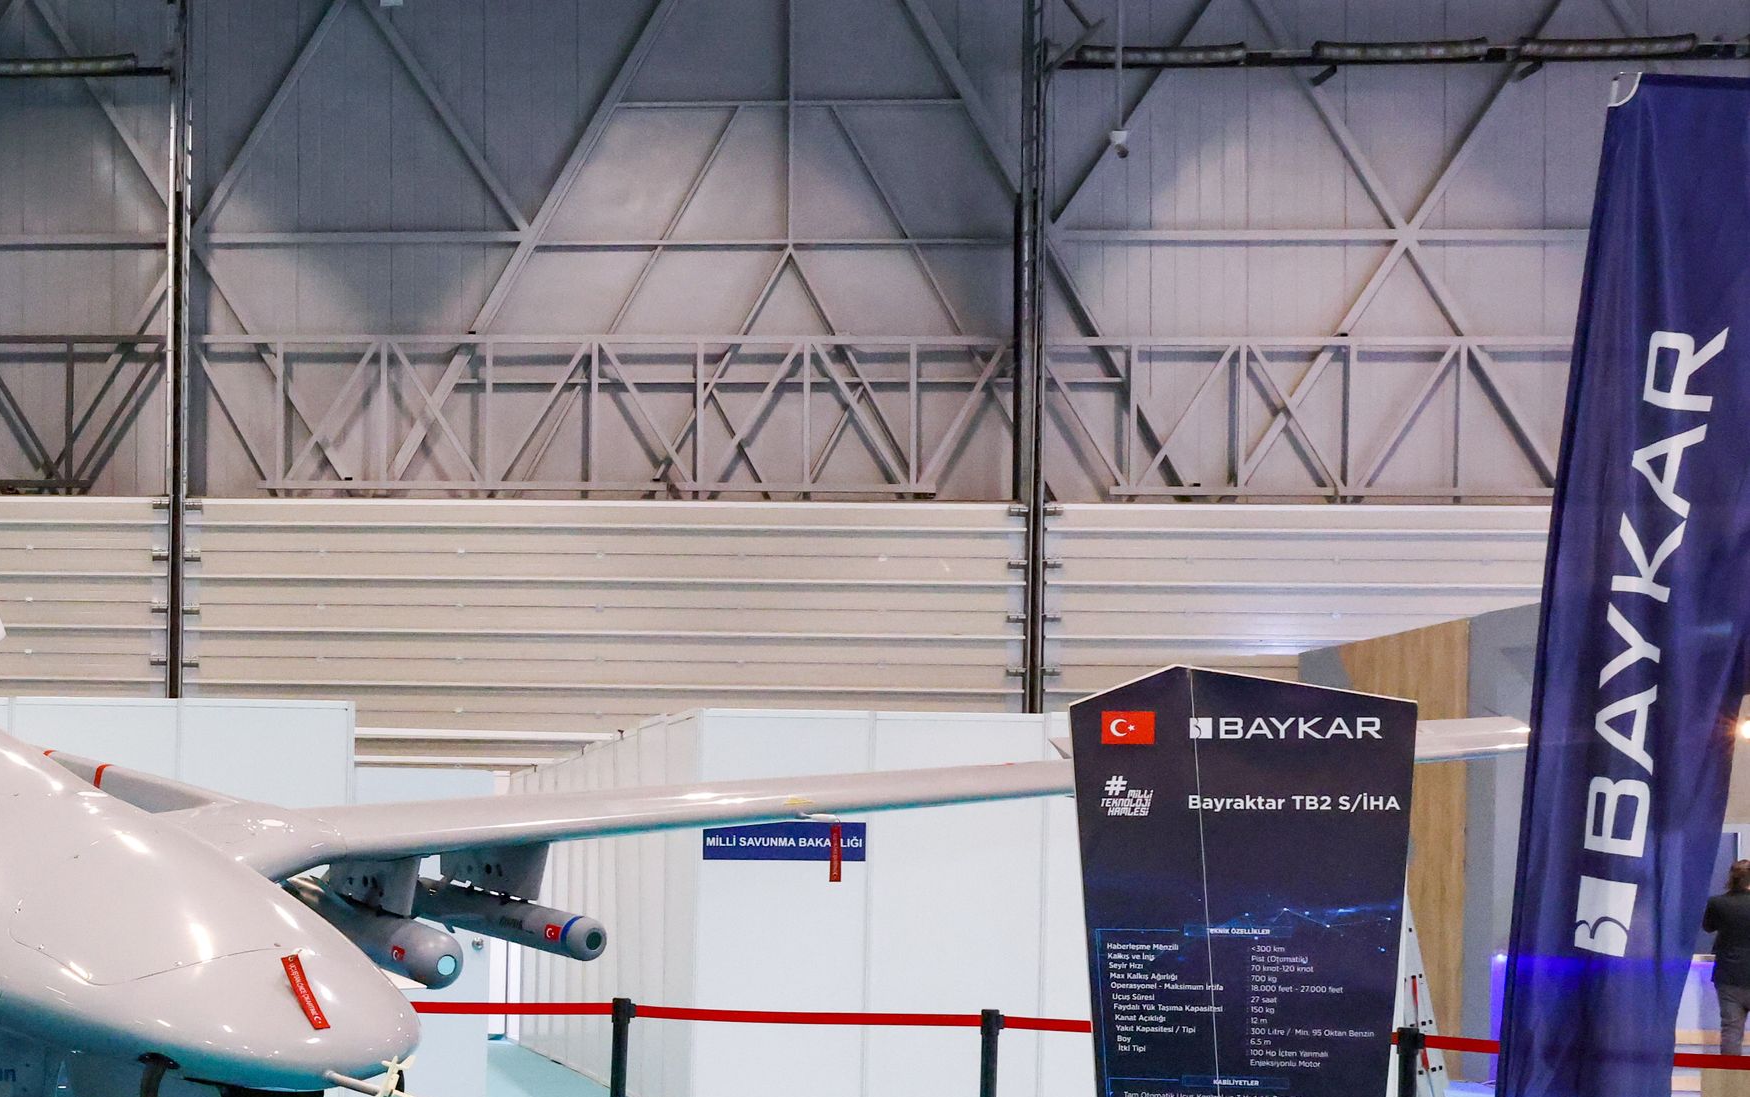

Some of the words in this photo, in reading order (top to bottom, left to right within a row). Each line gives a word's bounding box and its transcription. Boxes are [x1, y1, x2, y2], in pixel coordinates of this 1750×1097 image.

[1584, 326, 1730, 858] BAYKAR
[1219, 716, 1382, 739] BAYKAR
[1188, 794, 1285, 813] Bayraktar
[1292, 795, 1331, 810] TB2
[1338, 792, 1400, 813] S/İHA
[706, 834, 736, 847] MİLLİ
[739, 837, 796, 848] SAVUNMA
[799, 836, 862, 848] BAKALIĞI
[1106, 942, 1150, 951] Haberleşme
[1152, 943, 1179, 951] Menzili
[1262, 964, 1295, 972] knot-120
[1126, 972, 1149, 980] Kalkış
[1150, 973, 1178, 982] Ağırlığı
[1268, 975, 1278, 984] kg
[1110, 982, 1157, 990] Operasyonel
[1114, 1003, 1140, 1011] Faydalı
[1142, 1003, 1156, 1011] Yük
[1158, 1004, 1183, 1012] Taşıma
[1184, 1004, 1224, 1013] Kapasitesi
[1265, 1006, 1275, 1014] kg
[1138, 1014, 1166, 1023] Açıklığı
[1136, 1025, 1174, 1033] Kapasitesi
[1182, 1026, 1196, 1034] Tipi
[1324, 1029, 1347, 1037] Oktan
[1348, 1030, 1375, 1038] Benzin
[1117, 1034, 1132, 1043] Boy
[1266, 1049, 1276, 1057] Hp
[1250, 1060, 1296, 1068] Enjeksiyonlu
